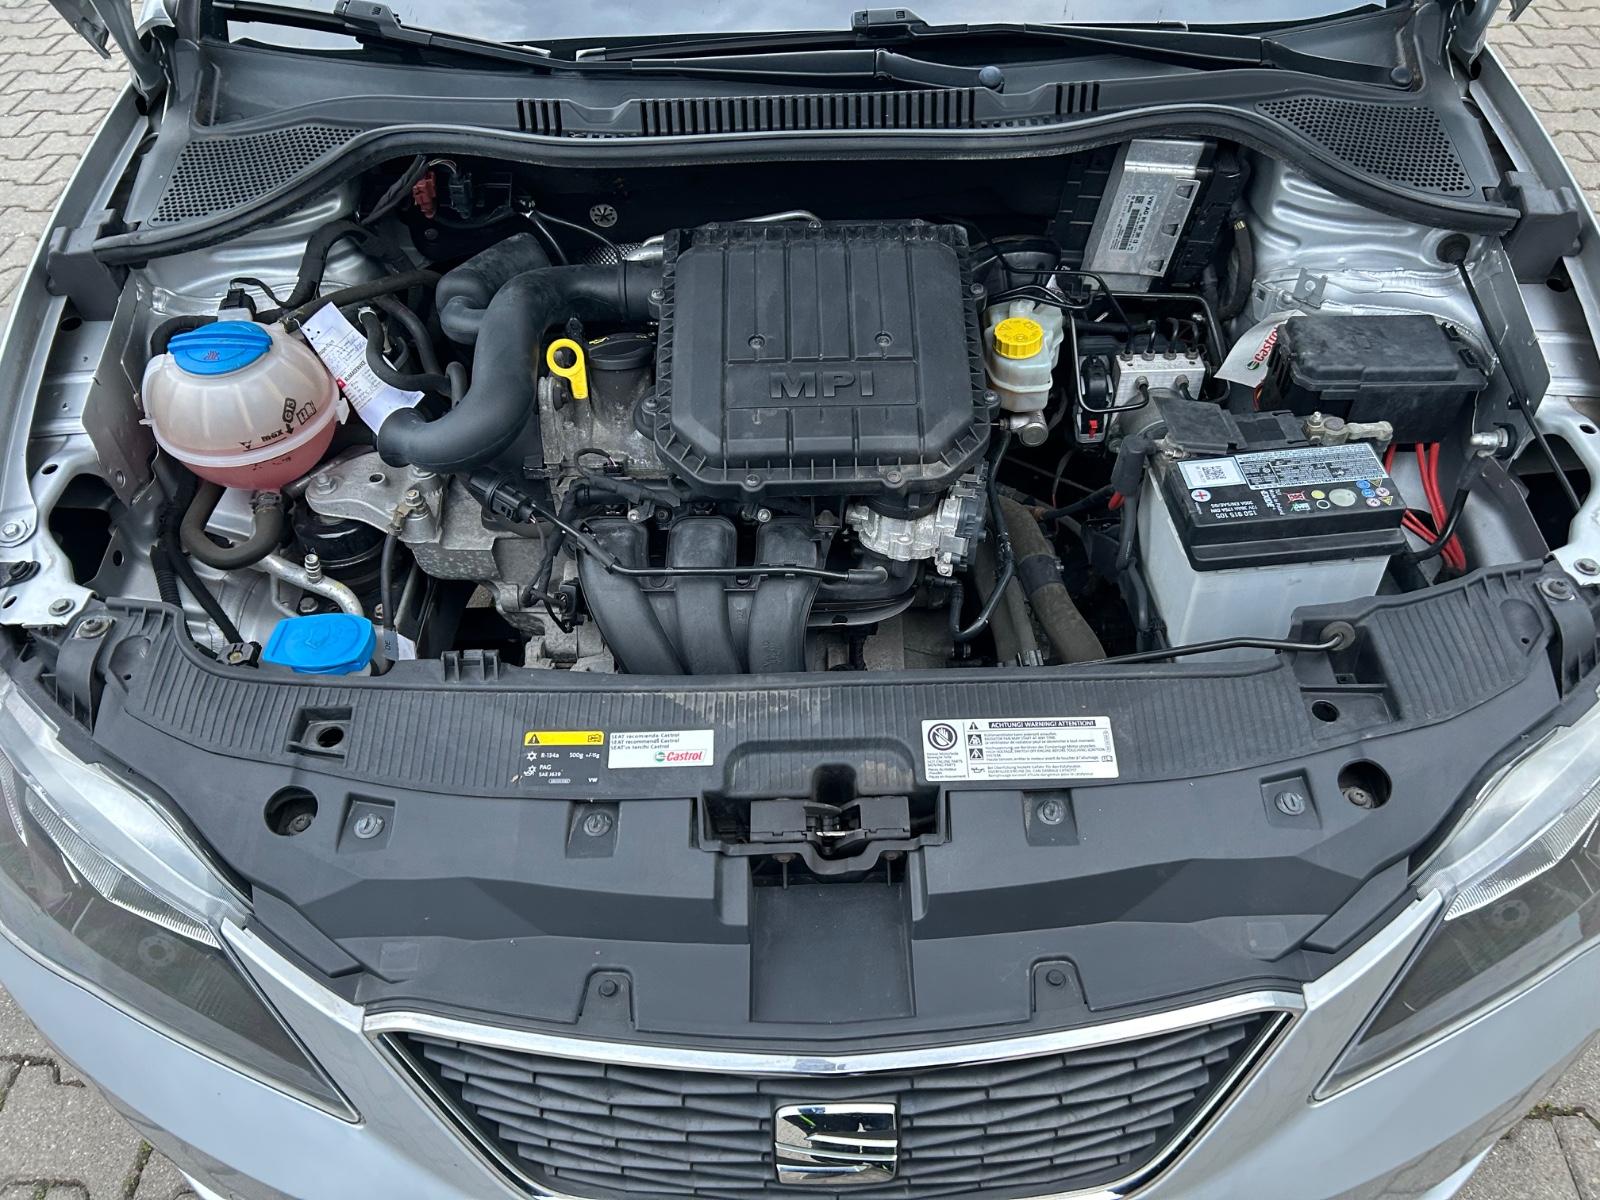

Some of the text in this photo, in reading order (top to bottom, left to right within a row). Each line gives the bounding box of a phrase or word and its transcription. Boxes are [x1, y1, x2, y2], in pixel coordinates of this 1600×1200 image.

[1254, 327, 1279, 362] Castro
[770, 370, 874, 398] MPI
[286, 400, 296, 422] G13
[260, 429, 284, 442] max
[384, 640, 391, 650] DE
[666, 750, 702, 761] Castrol
